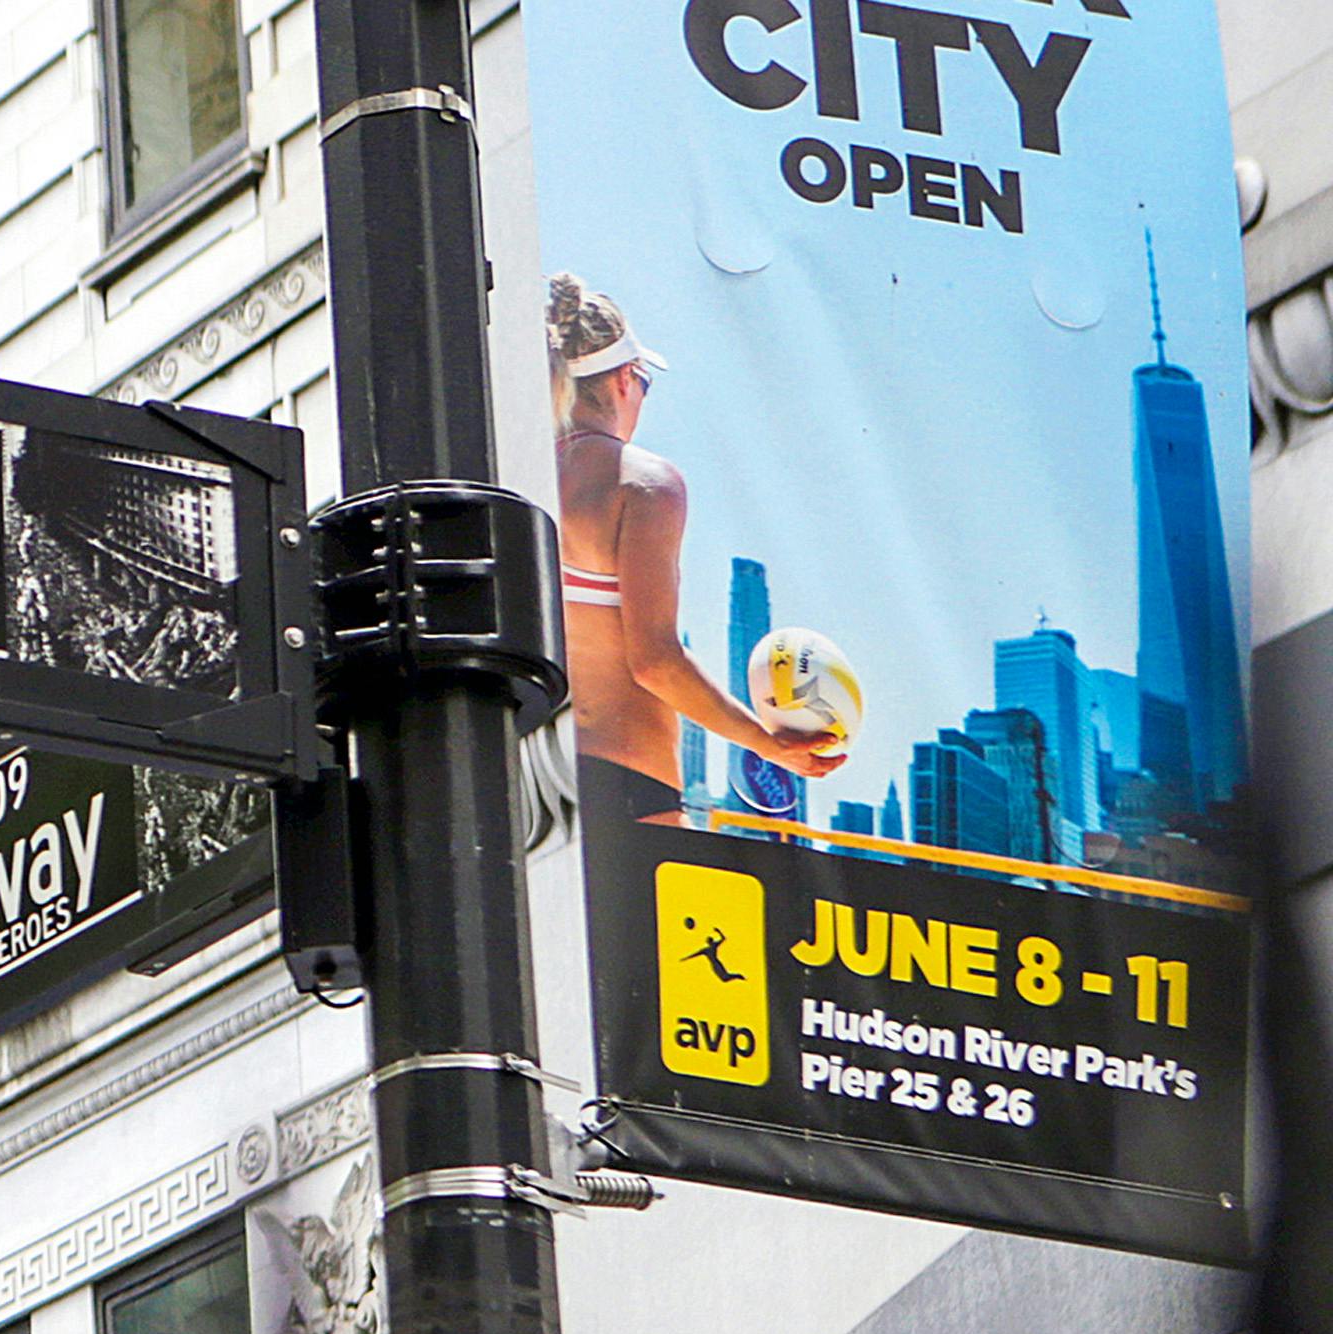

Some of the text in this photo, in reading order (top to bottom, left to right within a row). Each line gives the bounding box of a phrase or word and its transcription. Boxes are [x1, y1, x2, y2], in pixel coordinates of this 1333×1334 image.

[683, 0, 1092, 155] CITY
[780, 137, 1023, 234] OPEN
[789, 899, 999, 998] JUNE
[1015, 936, 1063, 1007] 8
[1126, 954, 1189, 1029] 11
[674, 1016, 757, 1067] avp
[800, 1052, 1036, 1128] Pier 25 & 26
[801, 998, 1198, 1100] Hudson River Park's
